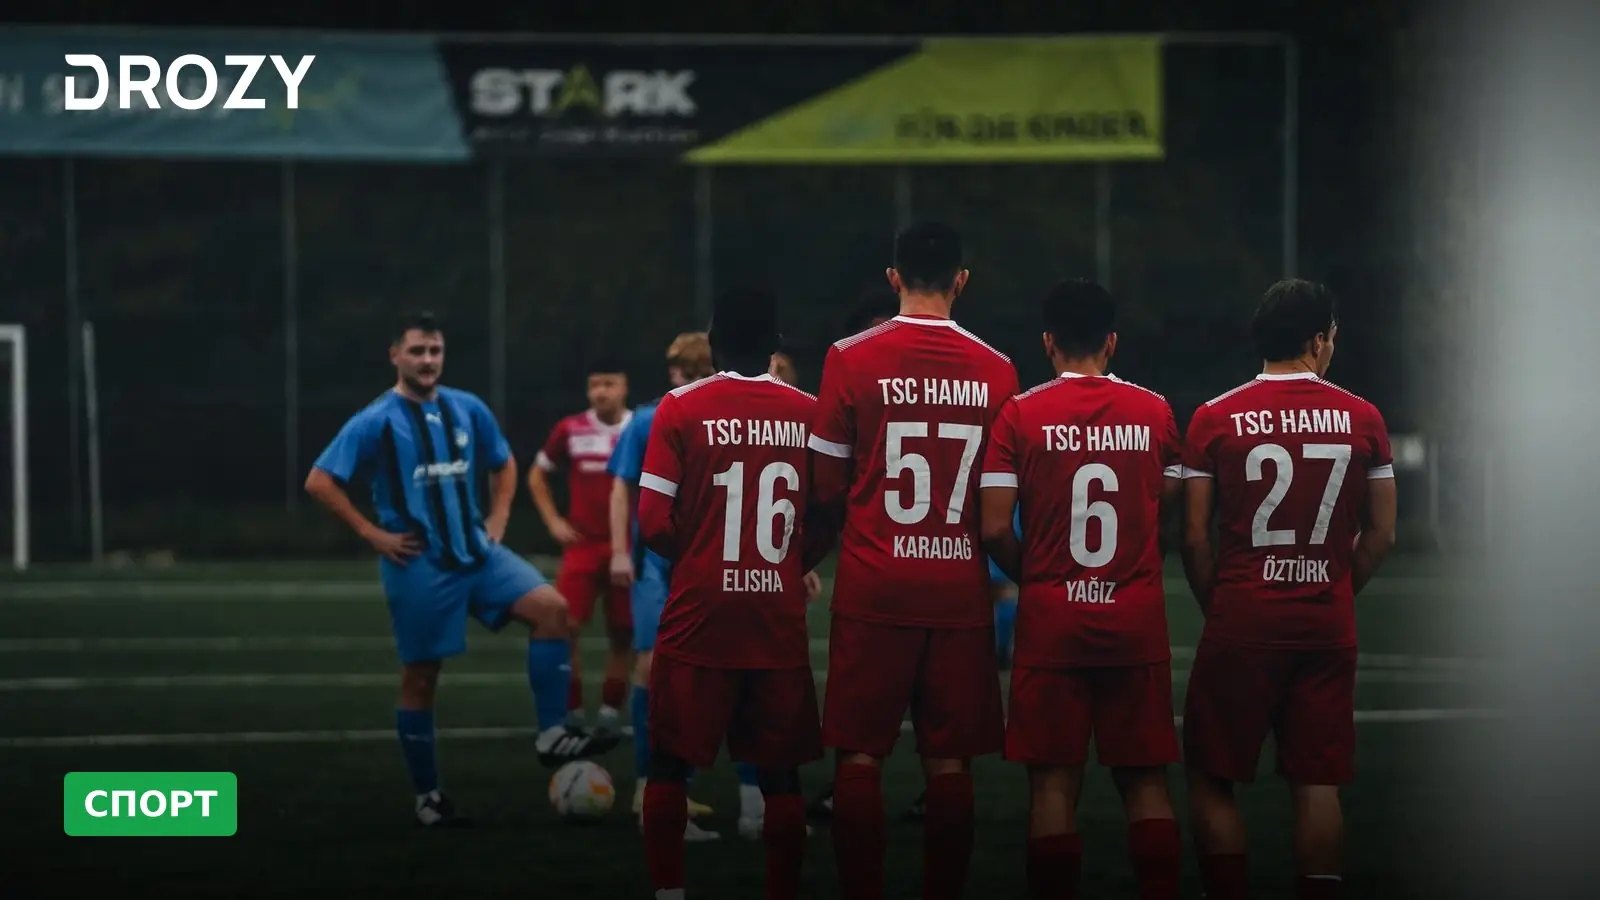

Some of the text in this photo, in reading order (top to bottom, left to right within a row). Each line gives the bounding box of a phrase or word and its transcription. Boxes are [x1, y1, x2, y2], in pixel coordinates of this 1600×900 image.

[469, 64, 697, 117] STARK
[877, 377, 989, 408] TSC HAMM
[702, 419, 806, 449] TSC HAMM
[1229, 408, 1352, 437] TSC HAMM
[1042, 424, 1150, 452] TSC HAMM
[884, 421, 983, 525] 57
[1245, 443, 1352, 548] 27
[712, 461, 800, 564] 16
[1069, 462, 1119, 568] 6
[893, 533, 973, 561] KARADAĞ
[722, 568, 784, 593] ELISHA
[1262, 554, 1330, 583] ÖZTÜRK
[1065, 576, 1116, 604] YAĞIZ
